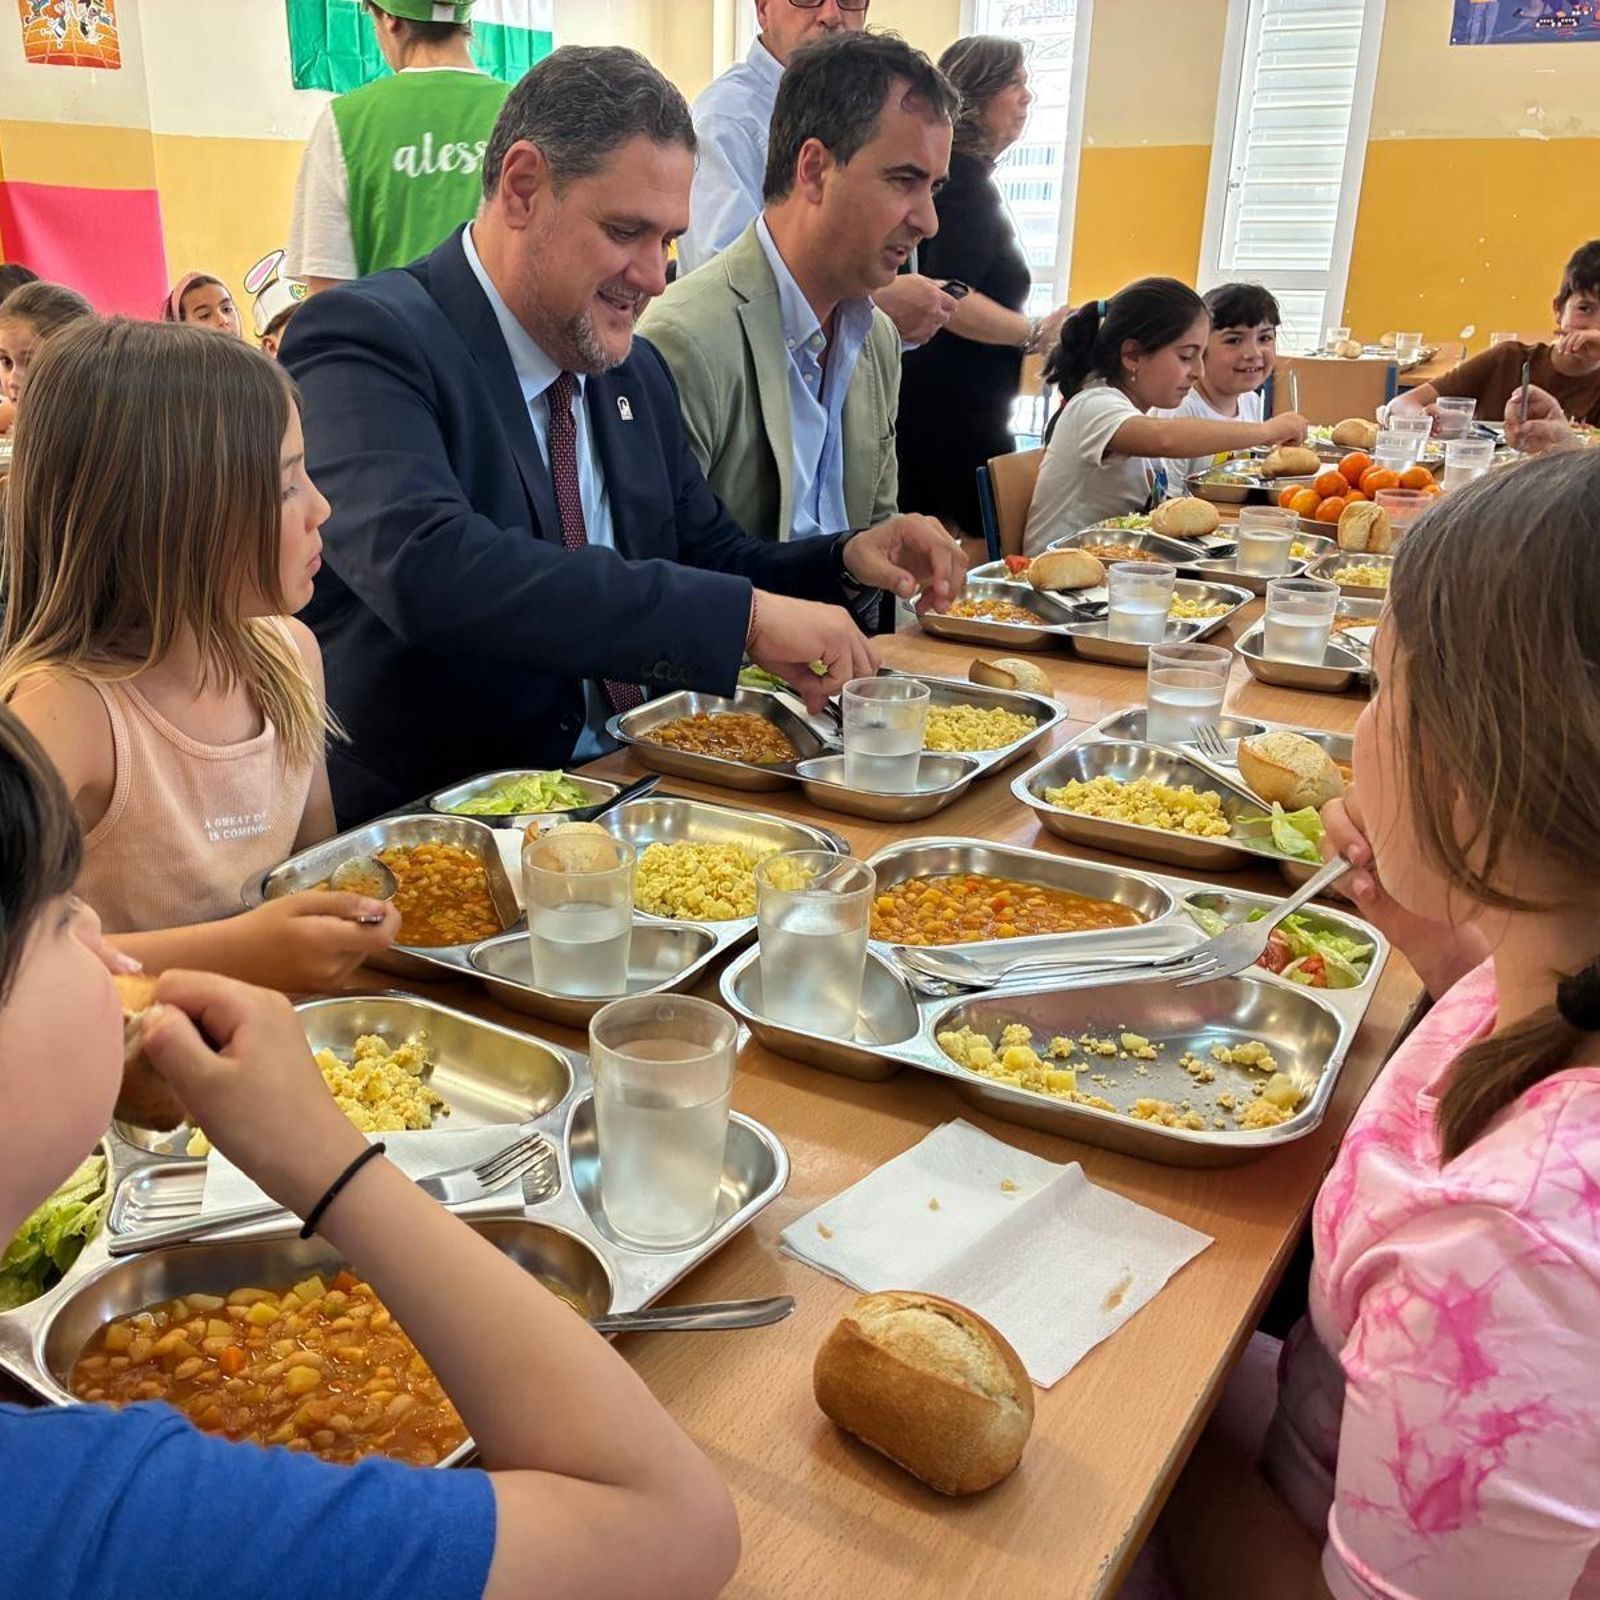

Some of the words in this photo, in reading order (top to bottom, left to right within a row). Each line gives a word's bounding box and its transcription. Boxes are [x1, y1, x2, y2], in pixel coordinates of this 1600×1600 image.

[204, 819, 212, 830] A
[214, 815, 250, 829] GREAT
[208, 830, 220, 841] IS
